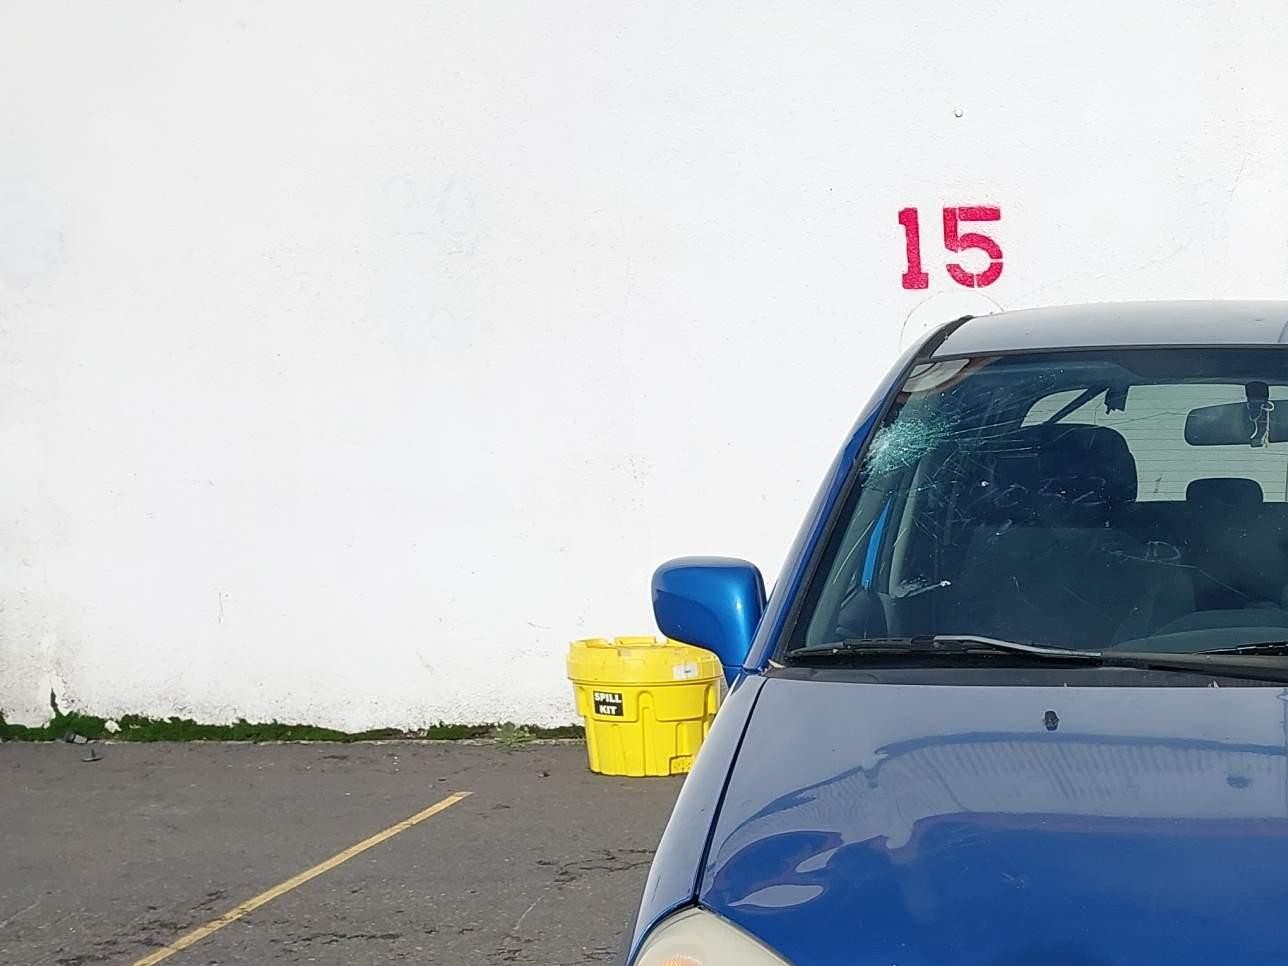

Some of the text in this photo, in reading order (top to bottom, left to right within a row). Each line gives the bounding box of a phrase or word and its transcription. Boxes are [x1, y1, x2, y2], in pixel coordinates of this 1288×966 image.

[898, 206, 1003, 289] 15
[594, 692, 622, 703] SPILL
[599, 705, 617, 715] KIT
